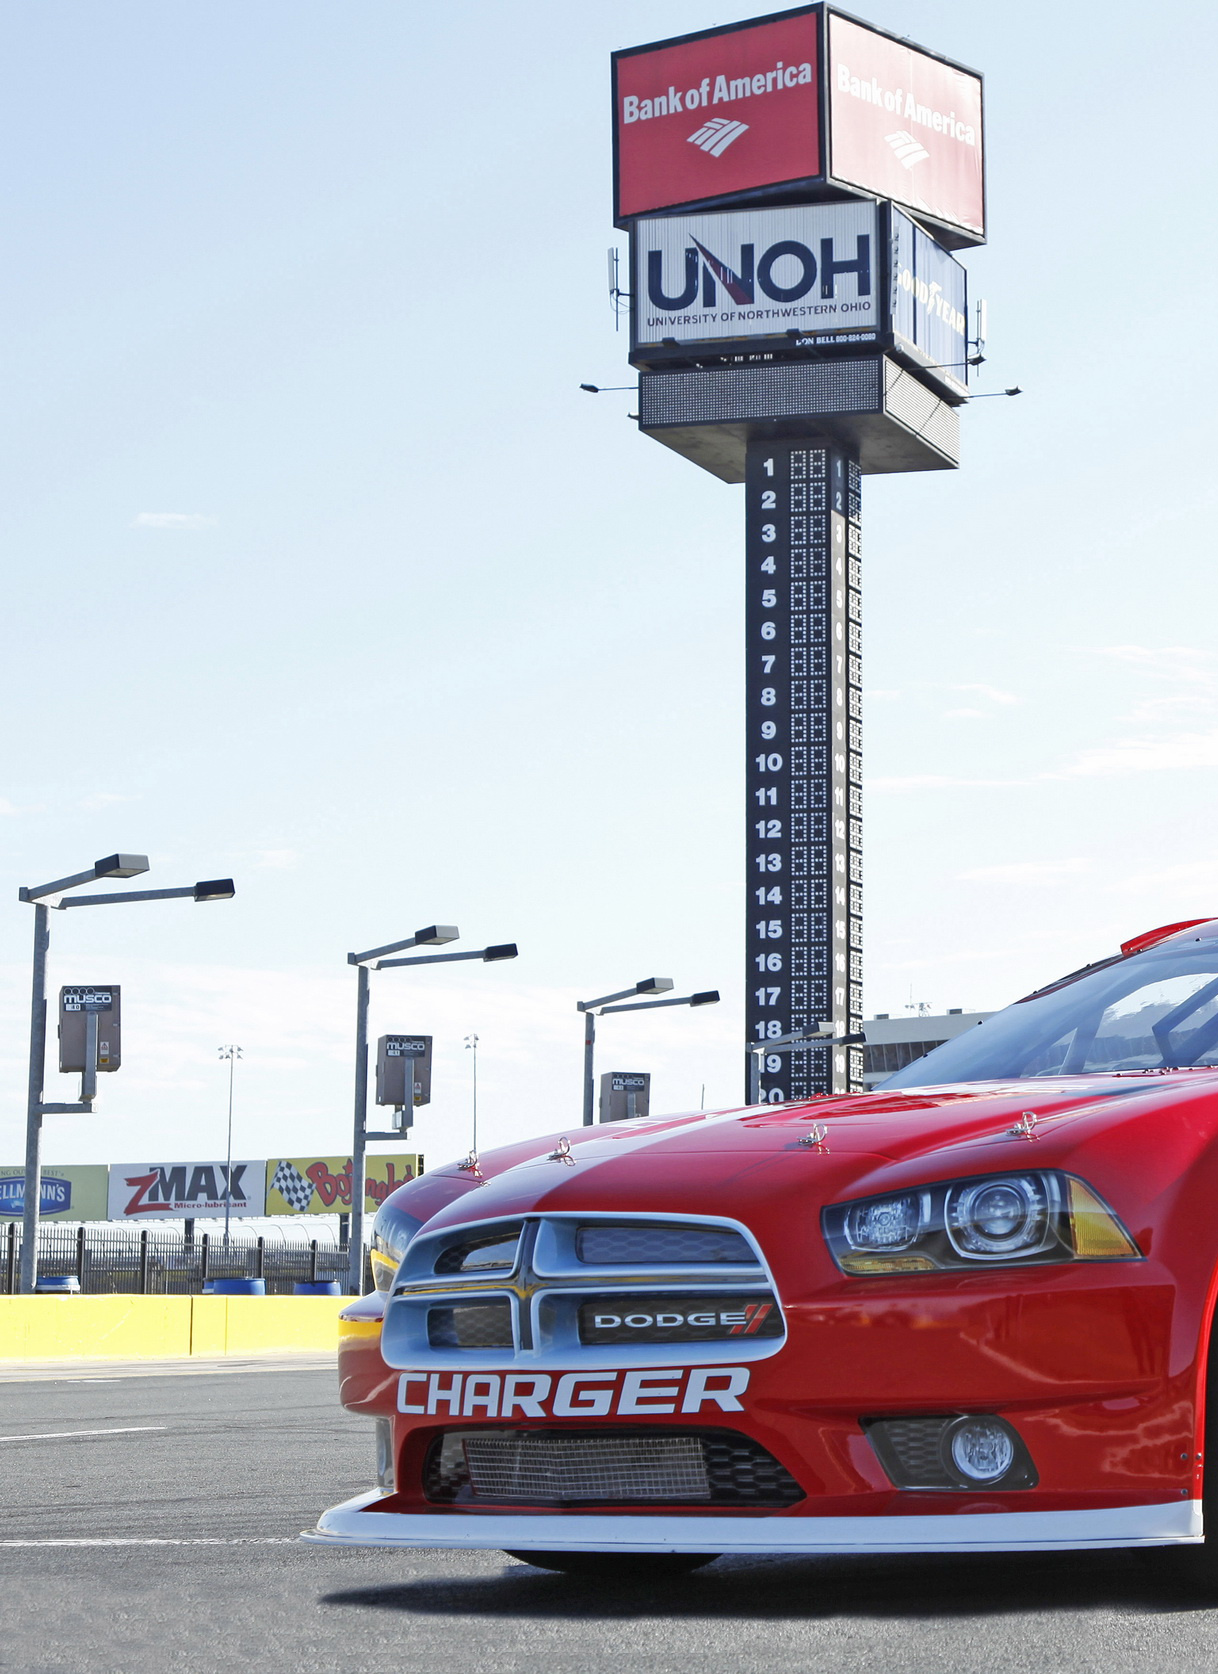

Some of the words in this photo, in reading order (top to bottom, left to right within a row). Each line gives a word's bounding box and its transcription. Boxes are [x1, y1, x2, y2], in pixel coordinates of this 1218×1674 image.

[624, 86, 683, 124] Bank
[685, 78, 710, 110] of
[713, 61, 812, 104] America
[837, 64, 883, 107] Bank
[884, 88, 903, 116] of
[904, 93, 976, 146] America
[648, 233, 871, 311] UNOH
[647, 312, 716, 327] UNIVERSITY
[720, 312, 737, 322] OF
[738, 304, 837, 321] NORTHWESTERN
[840, 301, 872, 313] OHIO
[816, 335, 835, 345] BELL
[764, 459, 773, 476] 1
[836, 460, 841, 477] 1
[762, 491, 776, 509] 2
[836, 491, 842, 510] 2
[762, 524, 776, 542] 3
[836, 525, 842, 543] 3
[761, 556, 776, 574] 4
[836, 557, 842, 575] 4
[762, 589, 776, 607] 5
[836, 590, 842, 608] 5
[761, 622, 775, 640] 6
[836, 622, 842, 641] 6
[762, 655, 775, 673] 7
[836, 655, 842, 673] 7
[761, 688, 776, 706] 8
[836, 688, 842, 706] 8
[762, 721, 776, 739] 9
[836, 721, 842, 740] 9
[756, 753, 782, 771] 10
[835, 753, 845, 773] 10
[756, 787, 776, 805] 11
[835, 787, 844, 806] 11
[756, 820, 781, 838] 12
[835, 820, 845, 839] 12
[756, 854, 781, 872] 13
[835, 853, 845, 873] 13
[756, 887, 782, 905] 14
[835, 886, 845, 905] 14
[756, 920, 782, 938] 15
[835, 920, 845, 939] 15
[756, 953, 782, 971] 16
[835, 953, 845, 972] 16
[756, 987, 780, 1005] 17
[835, 987, 845, 1005] 17
[755, 1020, 782, 1039] 18
[595, 1312, 747, 1329] DODGE
[397, 1366, 751, 1418] CHARGER
